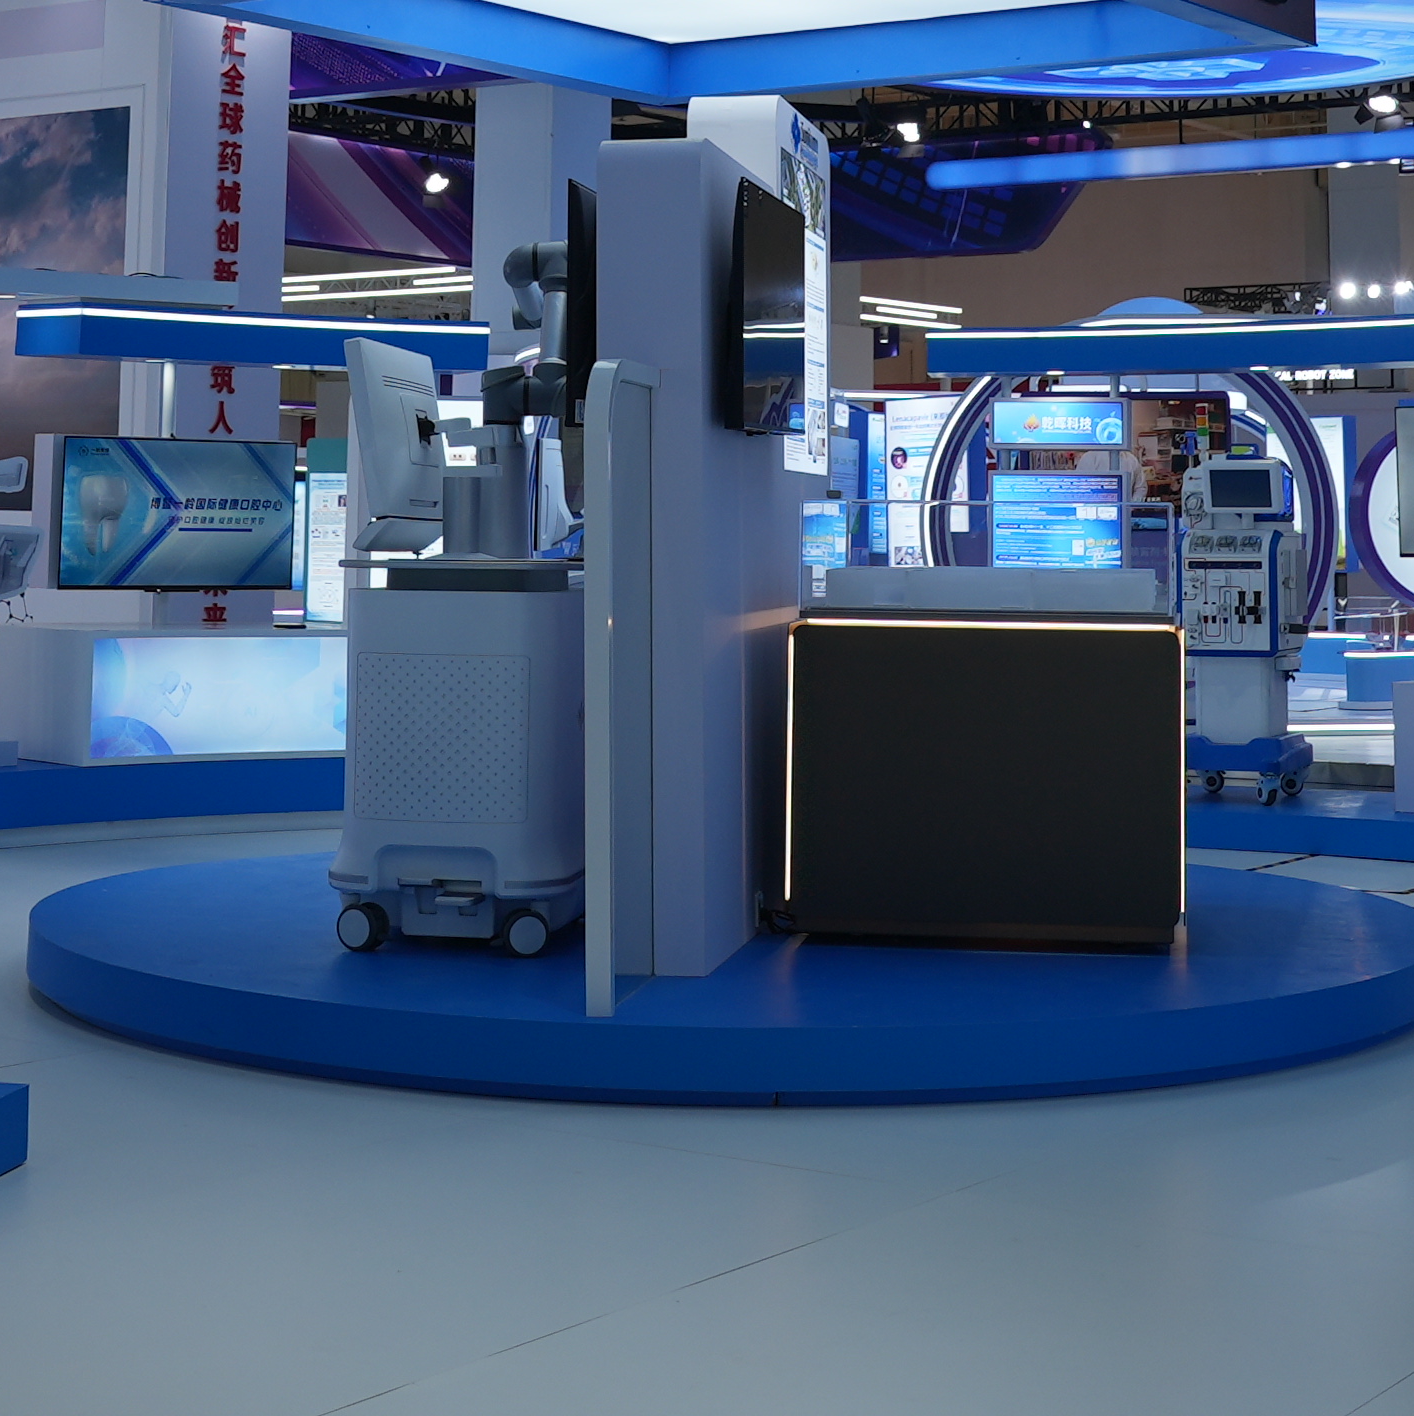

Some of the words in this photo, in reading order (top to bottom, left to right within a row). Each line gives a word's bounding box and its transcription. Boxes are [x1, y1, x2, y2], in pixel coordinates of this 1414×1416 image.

[213, 18, 247, 282] 汇全球药械创新
[1294, 369, 1328, 381] ROBOT
[1328, 368, 1354, 380] ZONE
